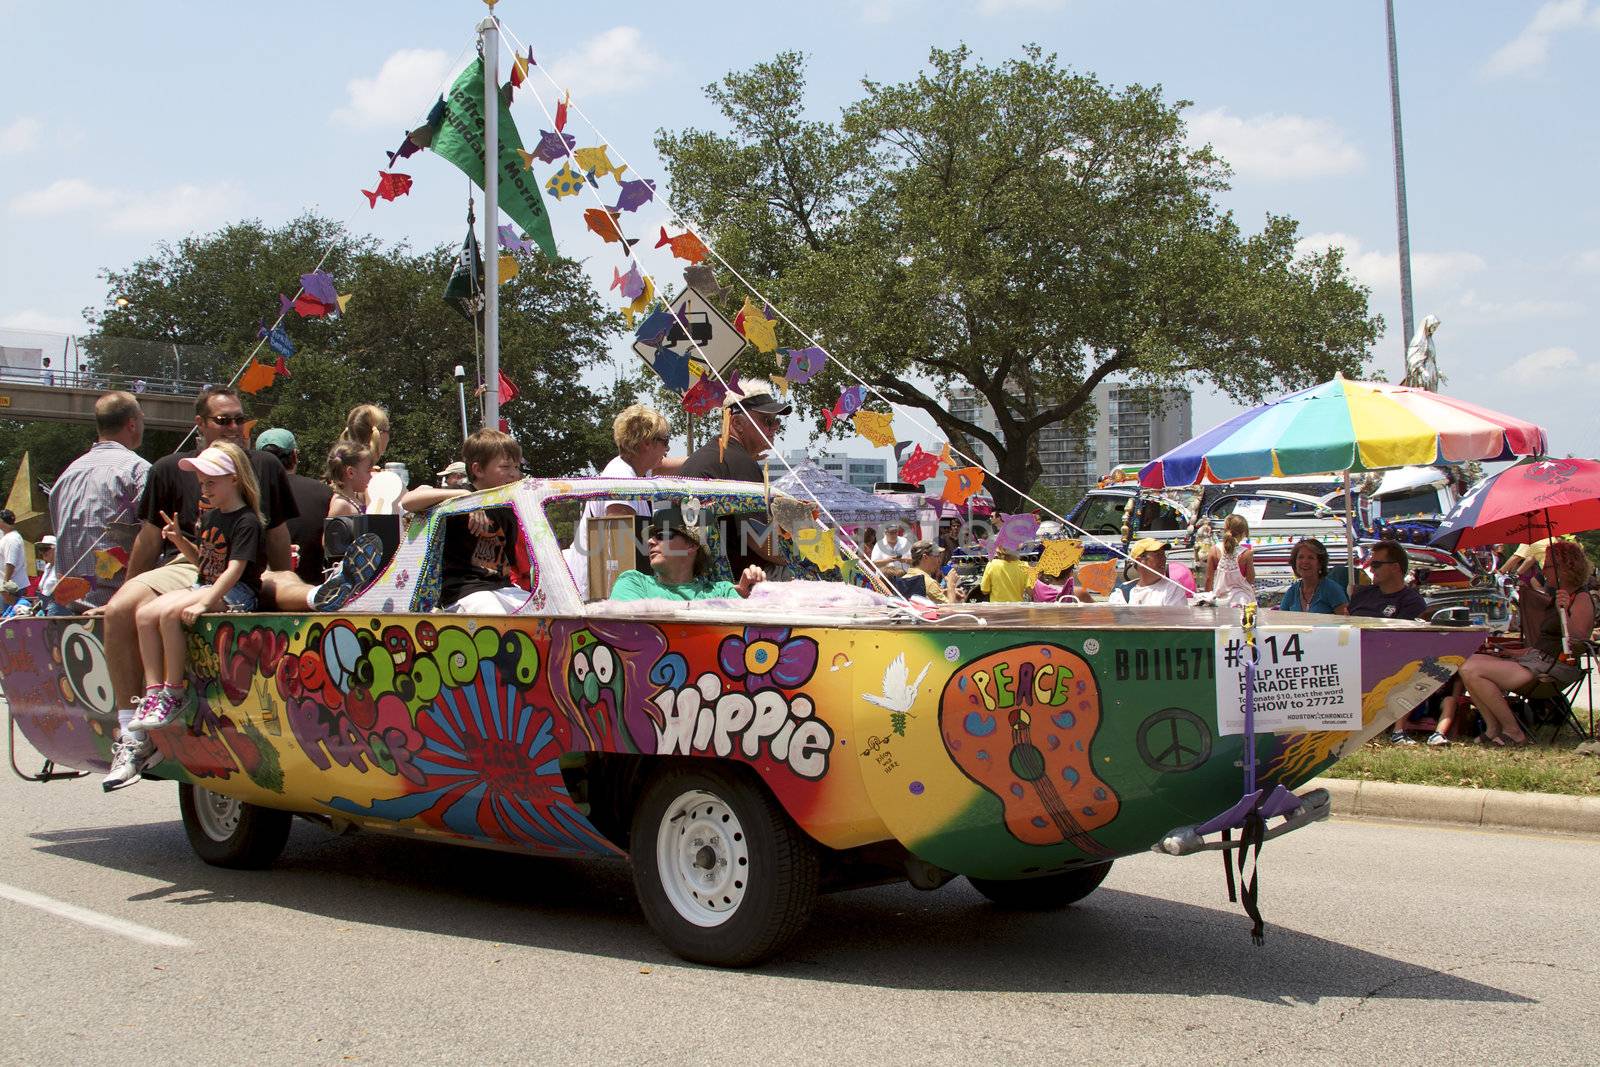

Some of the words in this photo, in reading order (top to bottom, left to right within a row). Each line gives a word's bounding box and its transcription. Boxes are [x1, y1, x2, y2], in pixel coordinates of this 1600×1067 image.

[504, 160, 543, 217] Morris
[1238, 669, 1272, 683] HLP
[1276, 665, 1311, 679] KEEP
[1312, 663, 1339, 675] THE
[971, 661, 1074, 711] PEACE
[1240, 679, 1297, 695] PARADE
[1301, 674, 1340, 689] FREE!
[1252, 694, 1275, 703] onate
[1293, 691, 1309, 700] text
[1310, 689, 1323, 698] the
[1324, 687, 1344, 695] word
[1291, 698, 1304, 708] to
[1306, 695, 1344, 707] 27722
